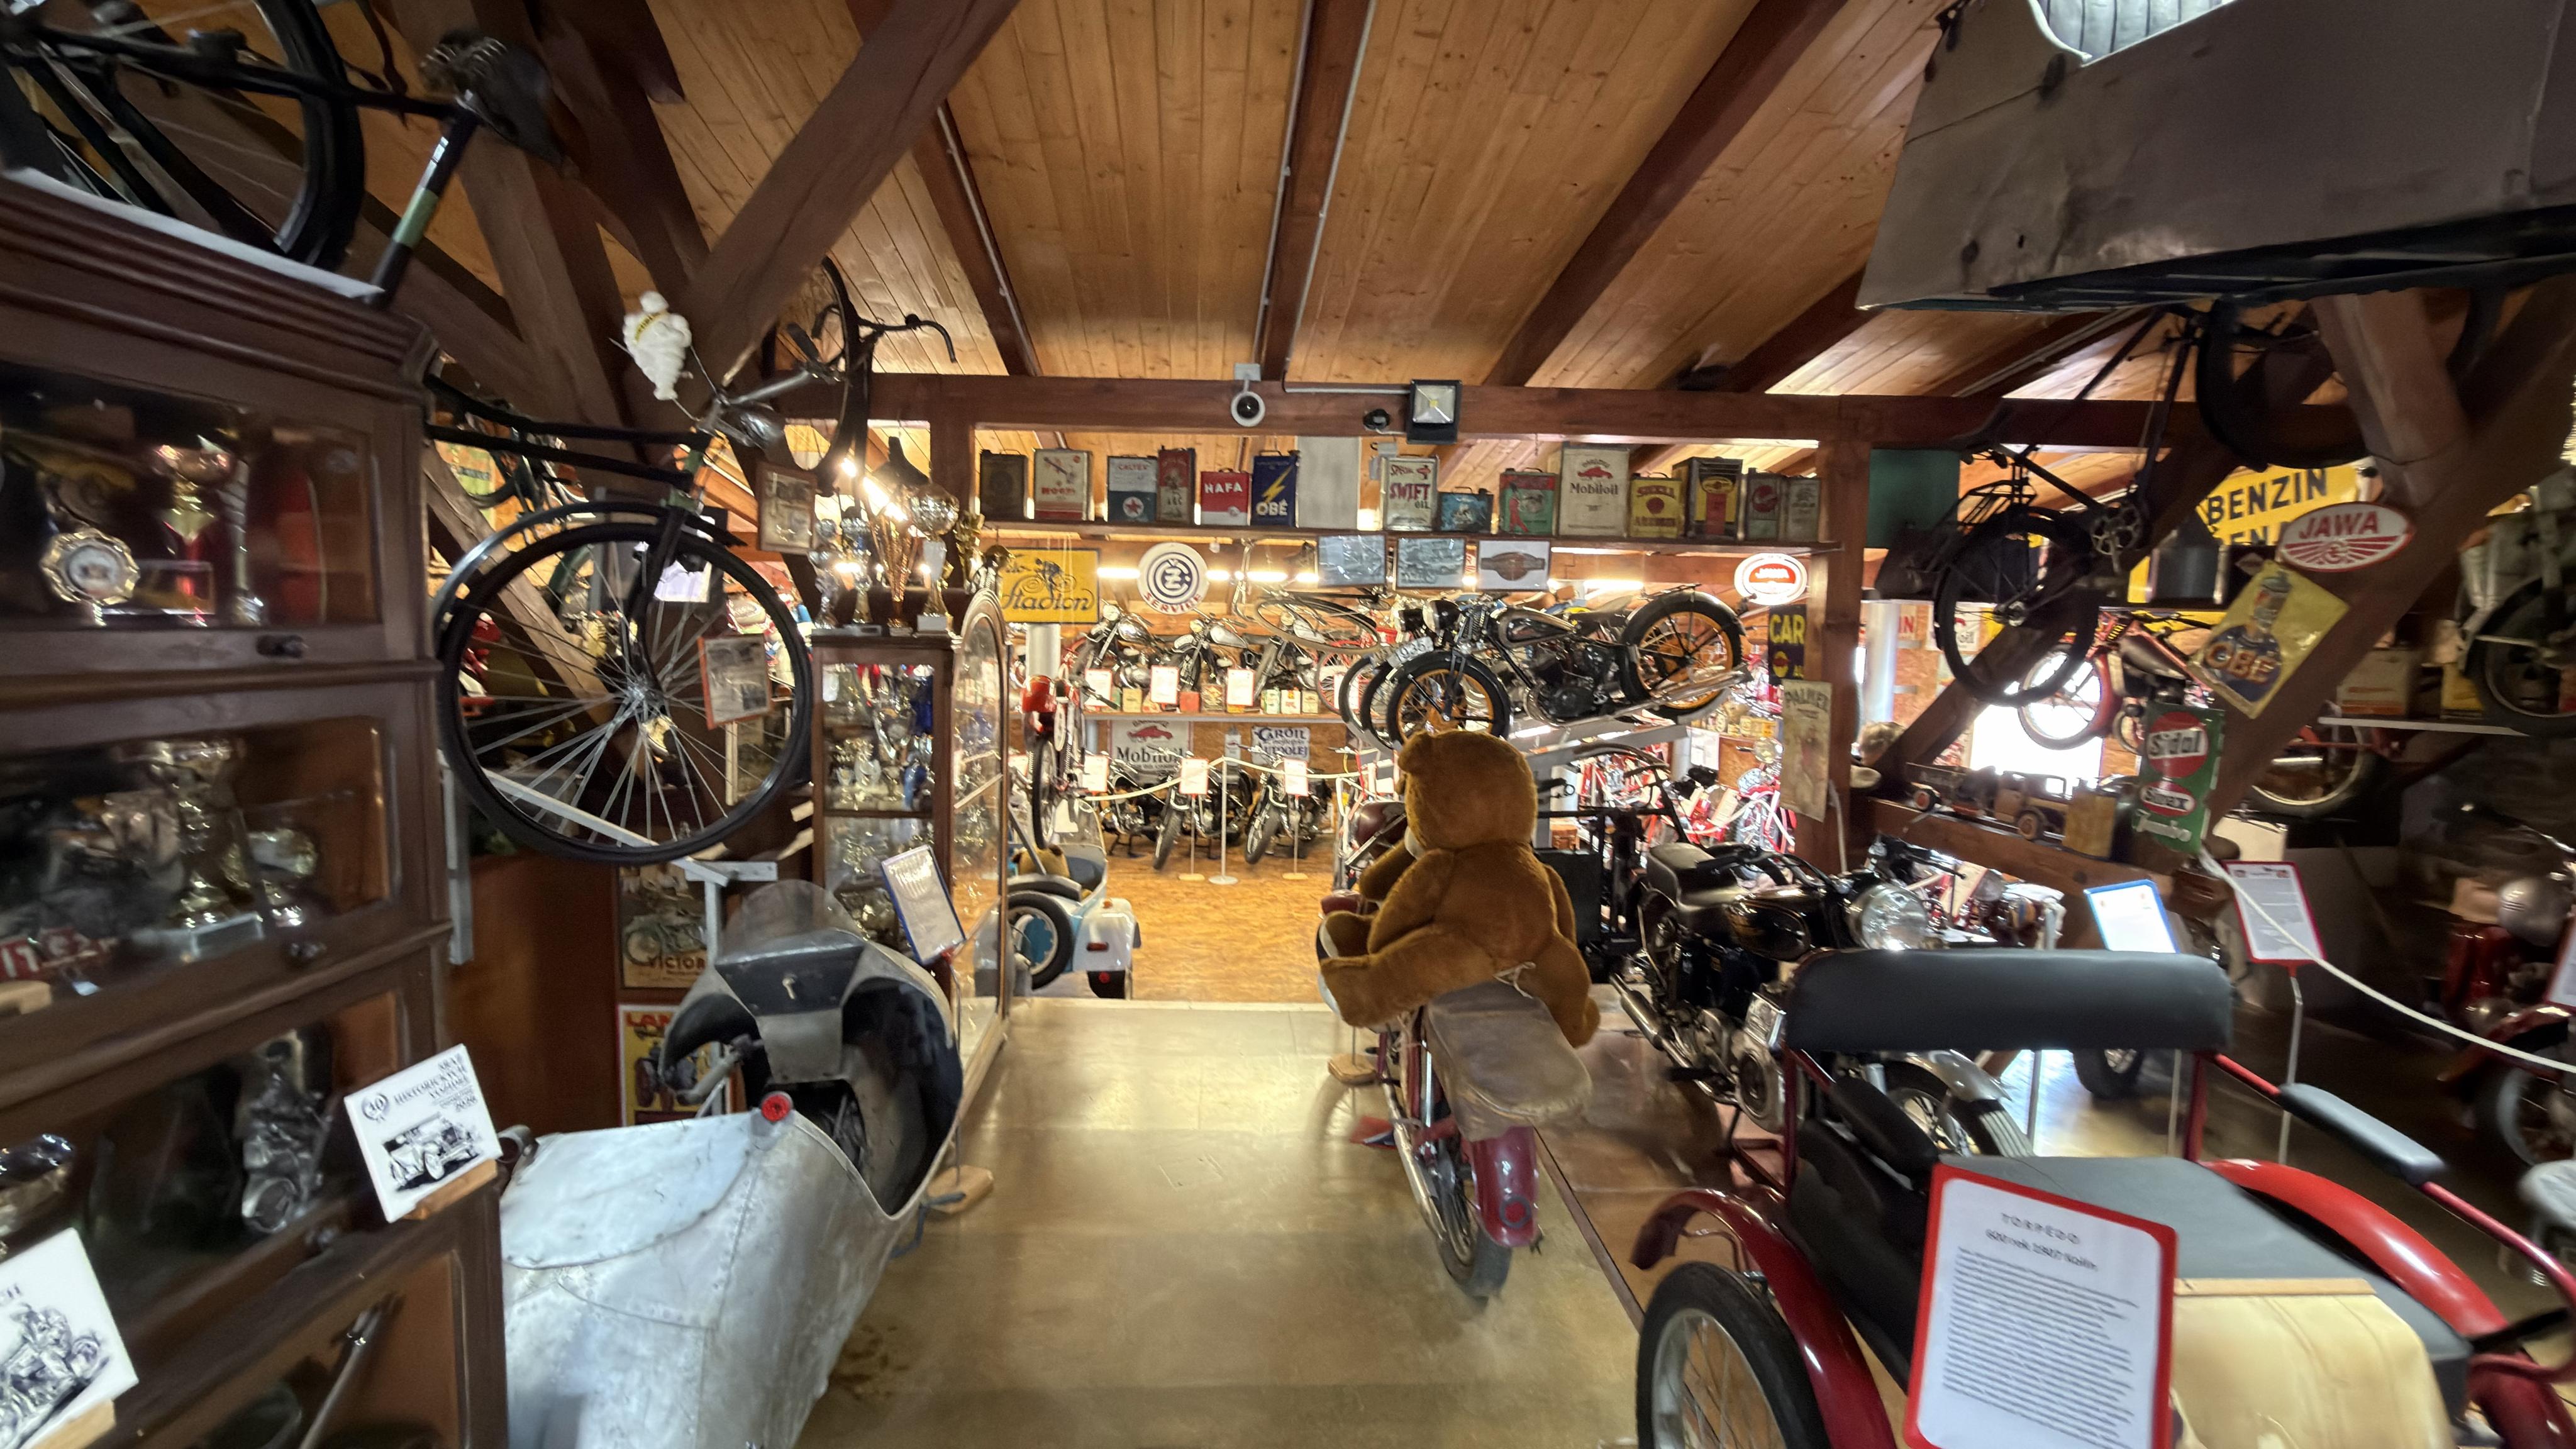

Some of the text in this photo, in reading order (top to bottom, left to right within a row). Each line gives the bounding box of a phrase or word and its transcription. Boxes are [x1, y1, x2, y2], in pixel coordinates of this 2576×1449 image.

[1389, 482, 1431, 502] SWIFT
[1570, 482, 1619, 496] Mobiloil
[2208, 469, 2326, 526] BENZIN
[2299, 511, 2378, 540] JAWA
[1770, 614, 1806, 645] CAR
[648, 955, 706, 970] VICTOR
[2001, 1212, 2080, 1245] TORPEDO
